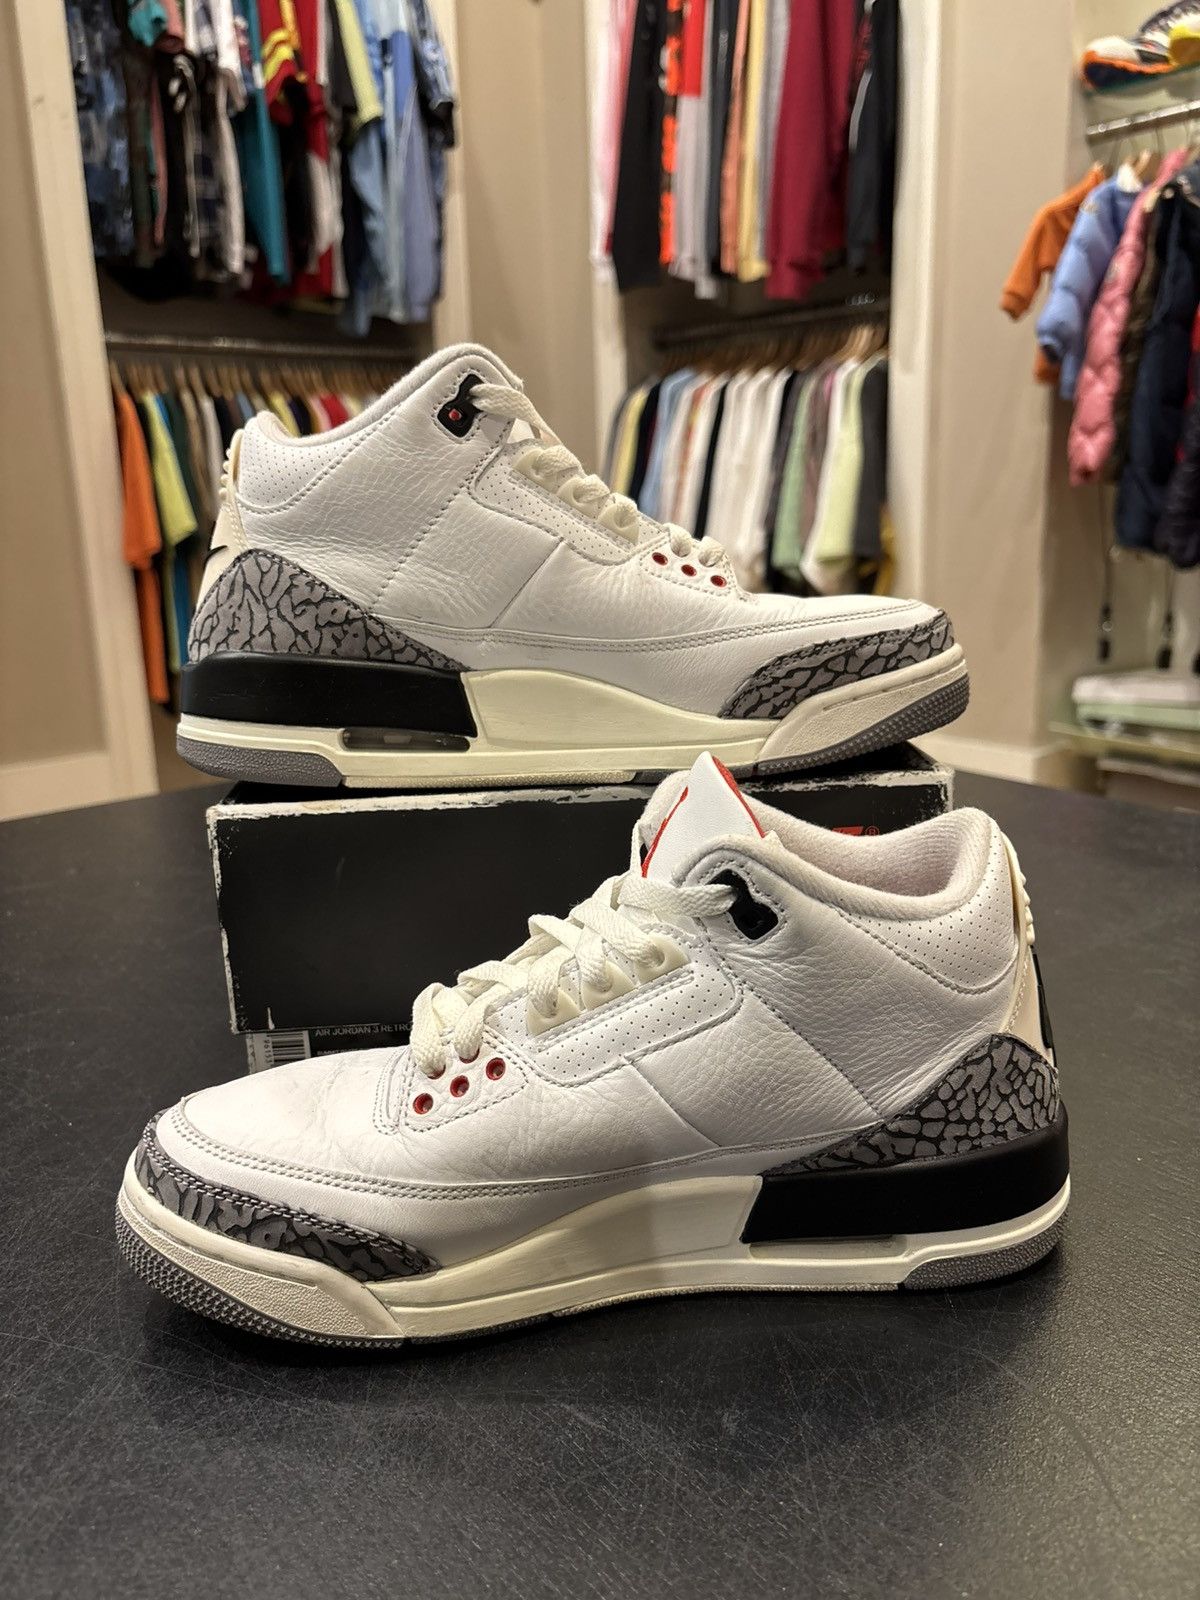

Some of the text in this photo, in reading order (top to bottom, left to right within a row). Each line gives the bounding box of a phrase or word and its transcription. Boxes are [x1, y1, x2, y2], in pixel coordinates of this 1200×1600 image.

[315, 1028, 330, 1036] AIR
[332, 1026, 371, 1035] JORDAN
[372, 1025, 379, 1033] 3
